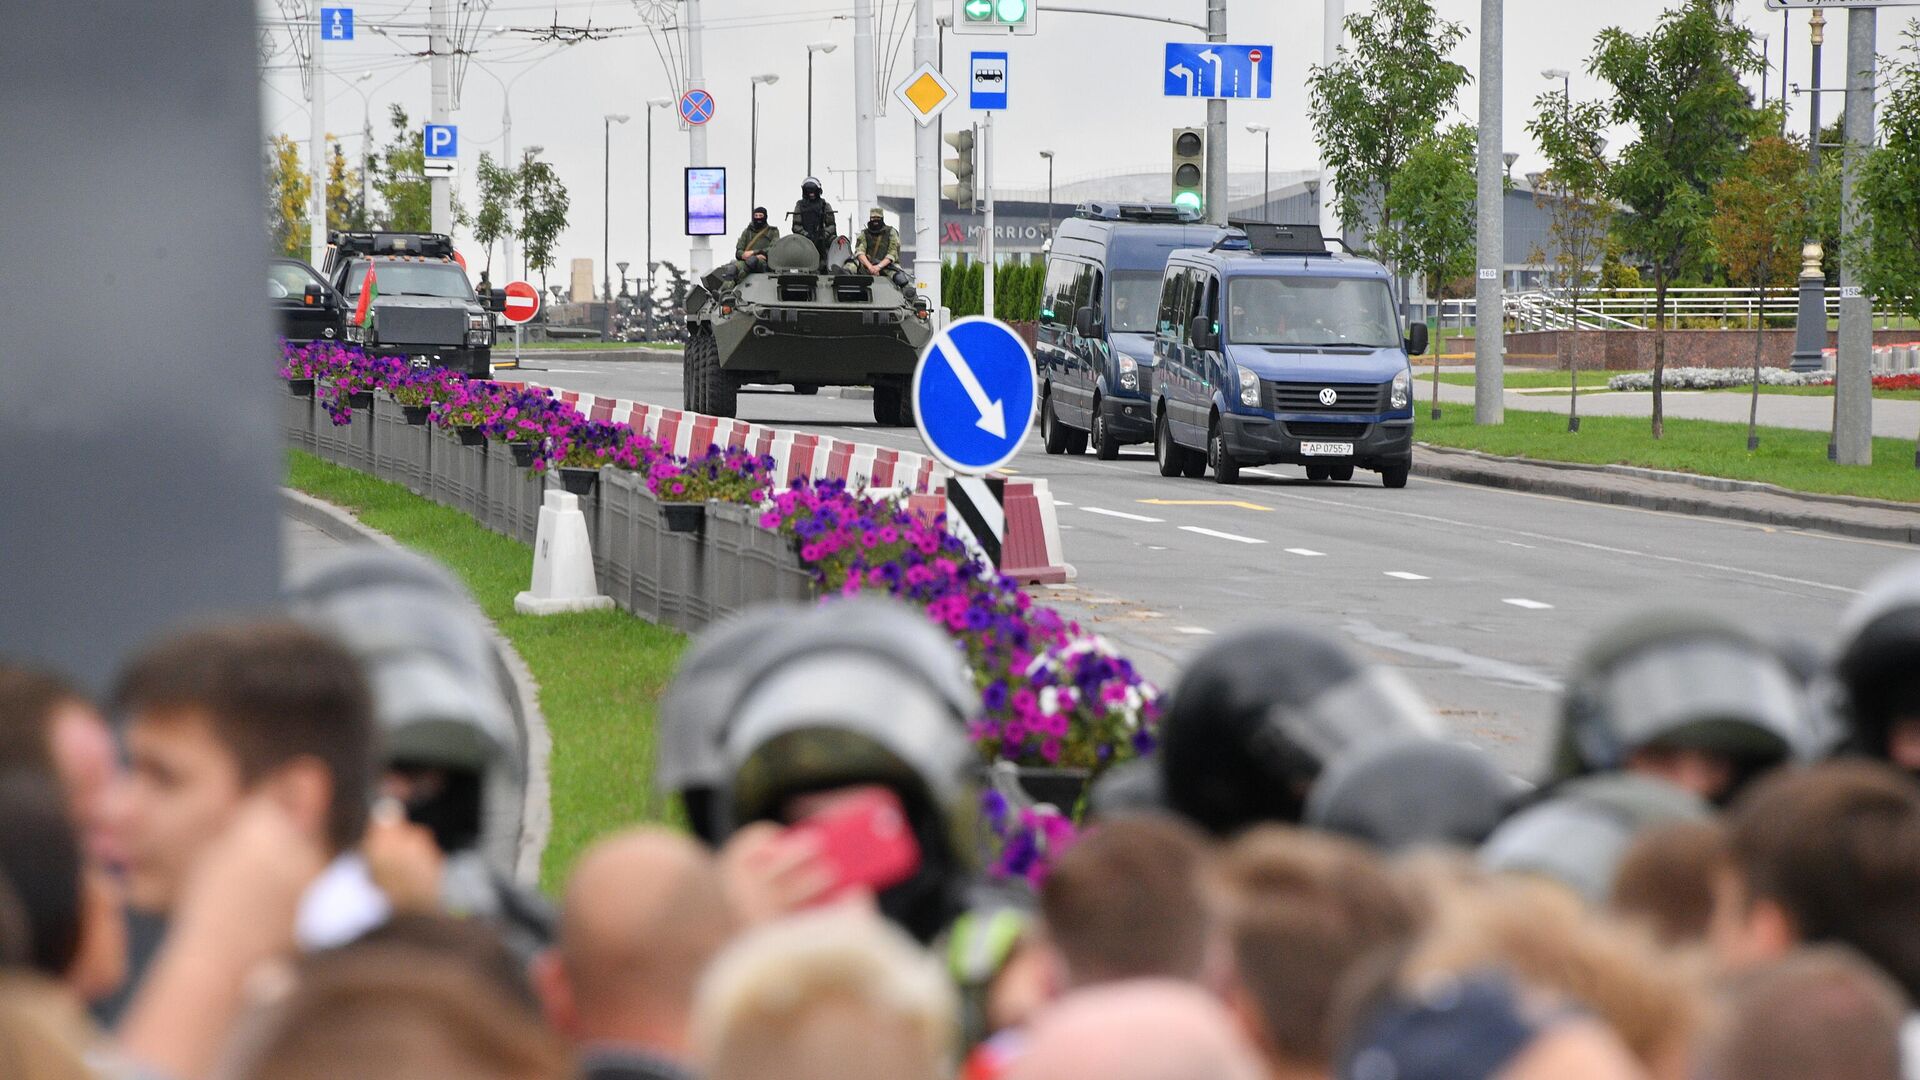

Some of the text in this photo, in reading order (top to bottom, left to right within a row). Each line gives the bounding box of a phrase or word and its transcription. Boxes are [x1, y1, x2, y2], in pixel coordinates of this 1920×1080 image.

[432, 127, 451, 155] P
[1310, 443, 1351, 454] AP 0755-7
